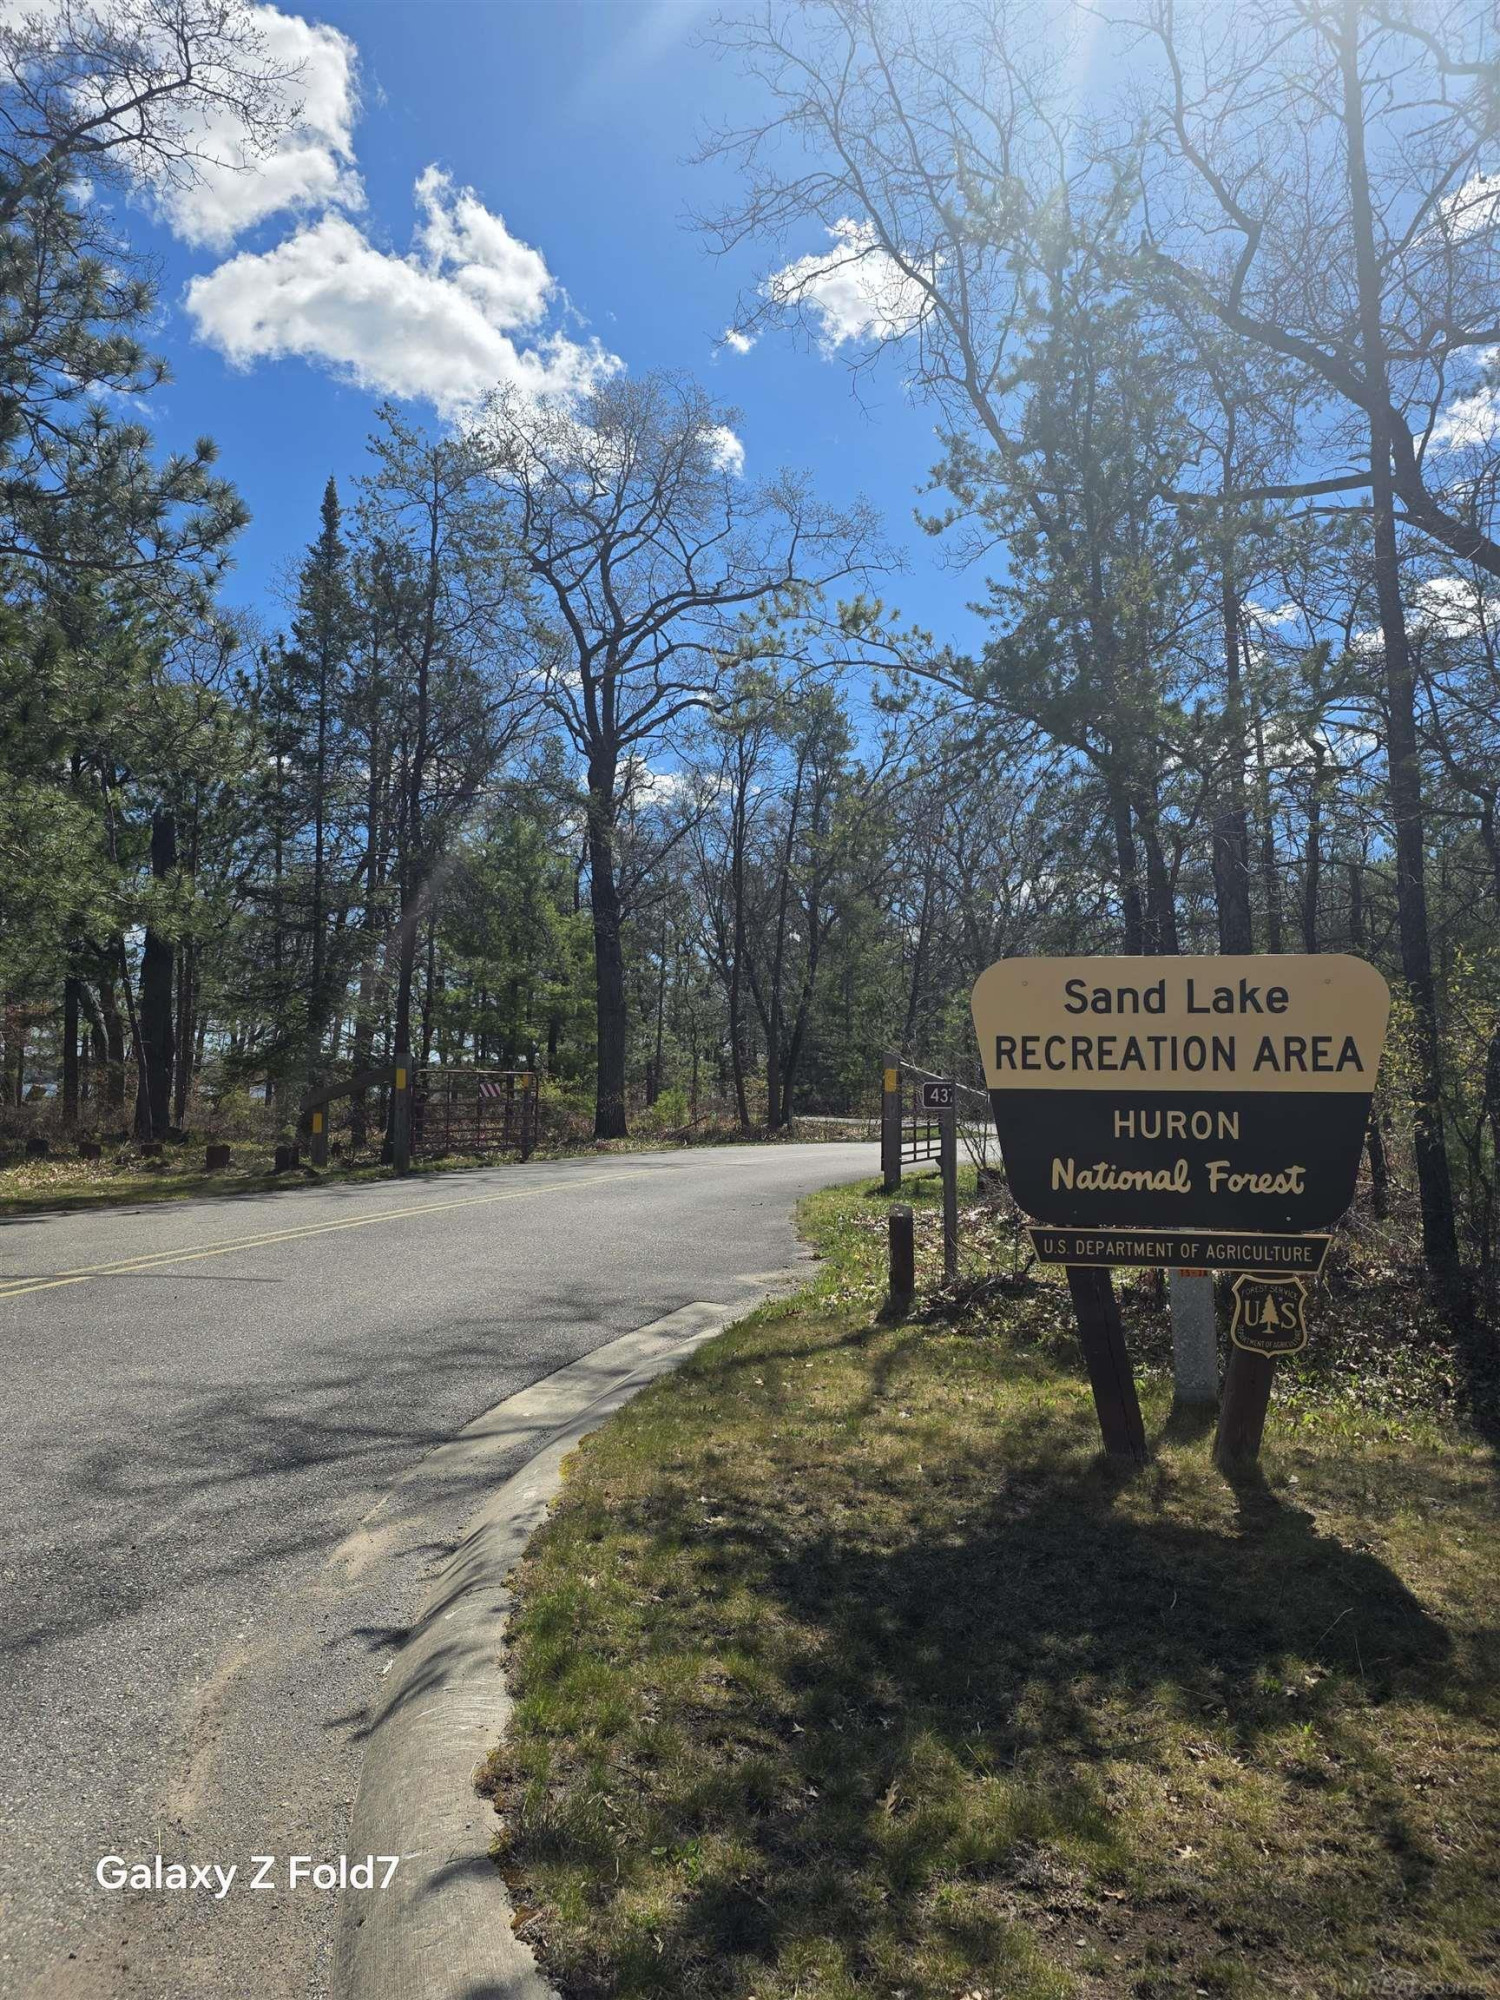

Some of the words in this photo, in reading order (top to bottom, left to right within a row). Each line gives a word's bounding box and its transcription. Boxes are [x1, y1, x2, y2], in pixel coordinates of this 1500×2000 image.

[1064, 978, 1166, 1014] Sand
[1187, 977, 1289, 1014] Lake
[995, 1035, 1236, 1071] RECREATION
[1253, 1035, 1364, 1072] AREA
[1114, 1110, 1240, 1140] HURON
[1051, 1157, 1191, 1193] National
[1205, 1160, 1306, 1195] Forest
[1044, 1239, 1070, 1255] U.S.
[1076, 1240, 1174, 1258] DEPARTMENT
[1180, 1243, 1200, 1259] OF
[1206, 1244, 1312, 1262] AGRICULTURE
